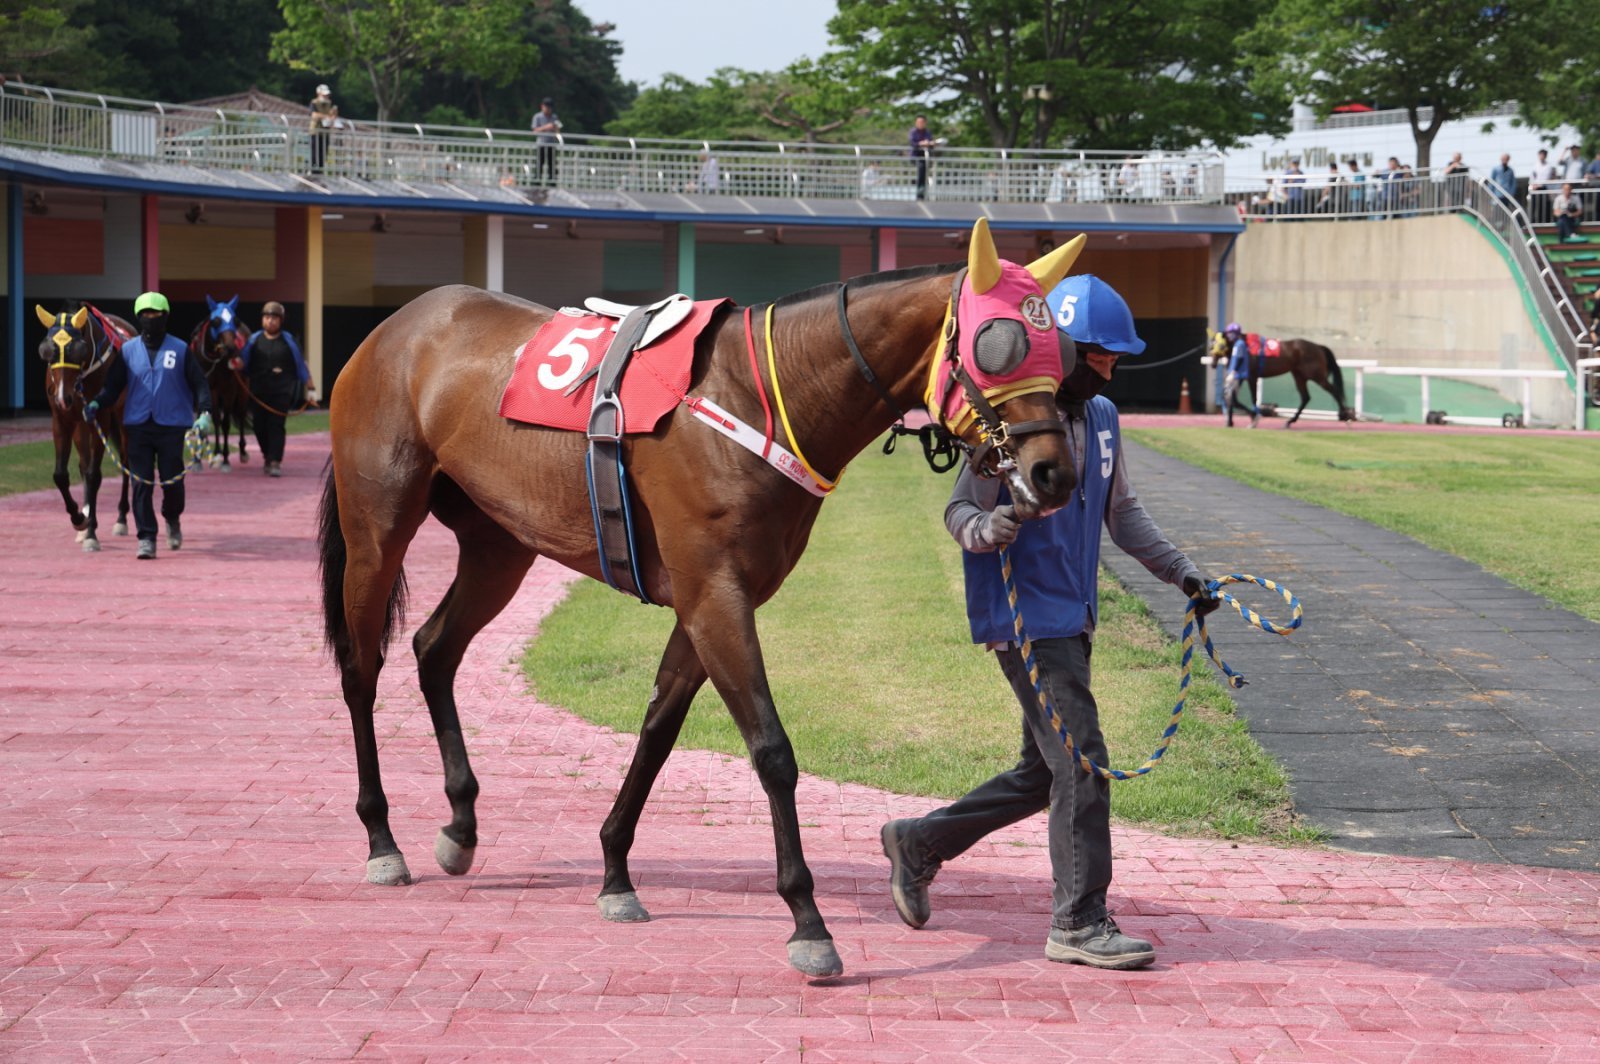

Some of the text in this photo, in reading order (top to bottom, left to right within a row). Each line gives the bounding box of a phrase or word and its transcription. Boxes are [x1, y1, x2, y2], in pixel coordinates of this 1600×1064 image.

[1057, 294, 1079, 327] 5
[163, 350, 177, 369] 6
[537, 327, 605, 390] 5
[1097, 429, 1113, 479] 5
